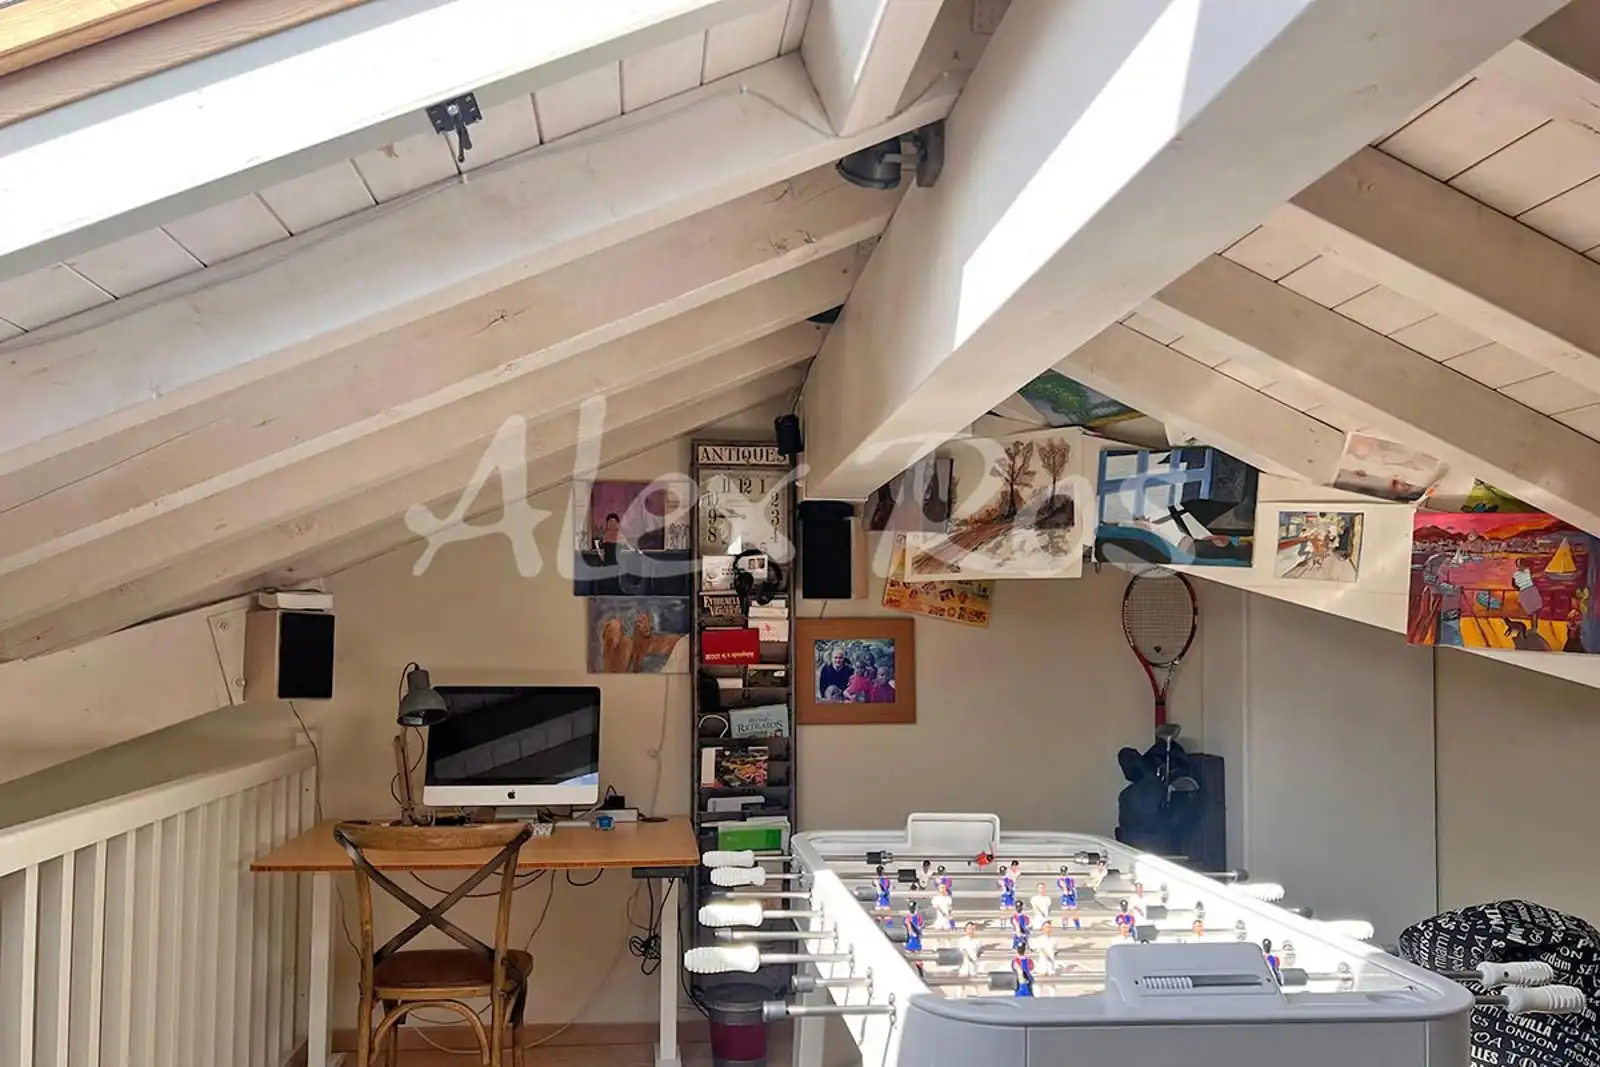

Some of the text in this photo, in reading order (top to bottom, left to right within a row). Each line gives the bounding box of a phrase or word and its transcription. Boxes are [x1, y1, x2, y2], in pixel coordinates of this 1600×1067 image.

[739, 478, 752, 494] 12
[770, 492, 779, 508] 2
[707, 508, 717, 526] 9
[770, 509, 780, 525] 3
[707, 526, 717, 543] 8
[1505, 1012, 1552, 1038] SEVILLA
[1495, 1021, 1558, 1052] LONDON
